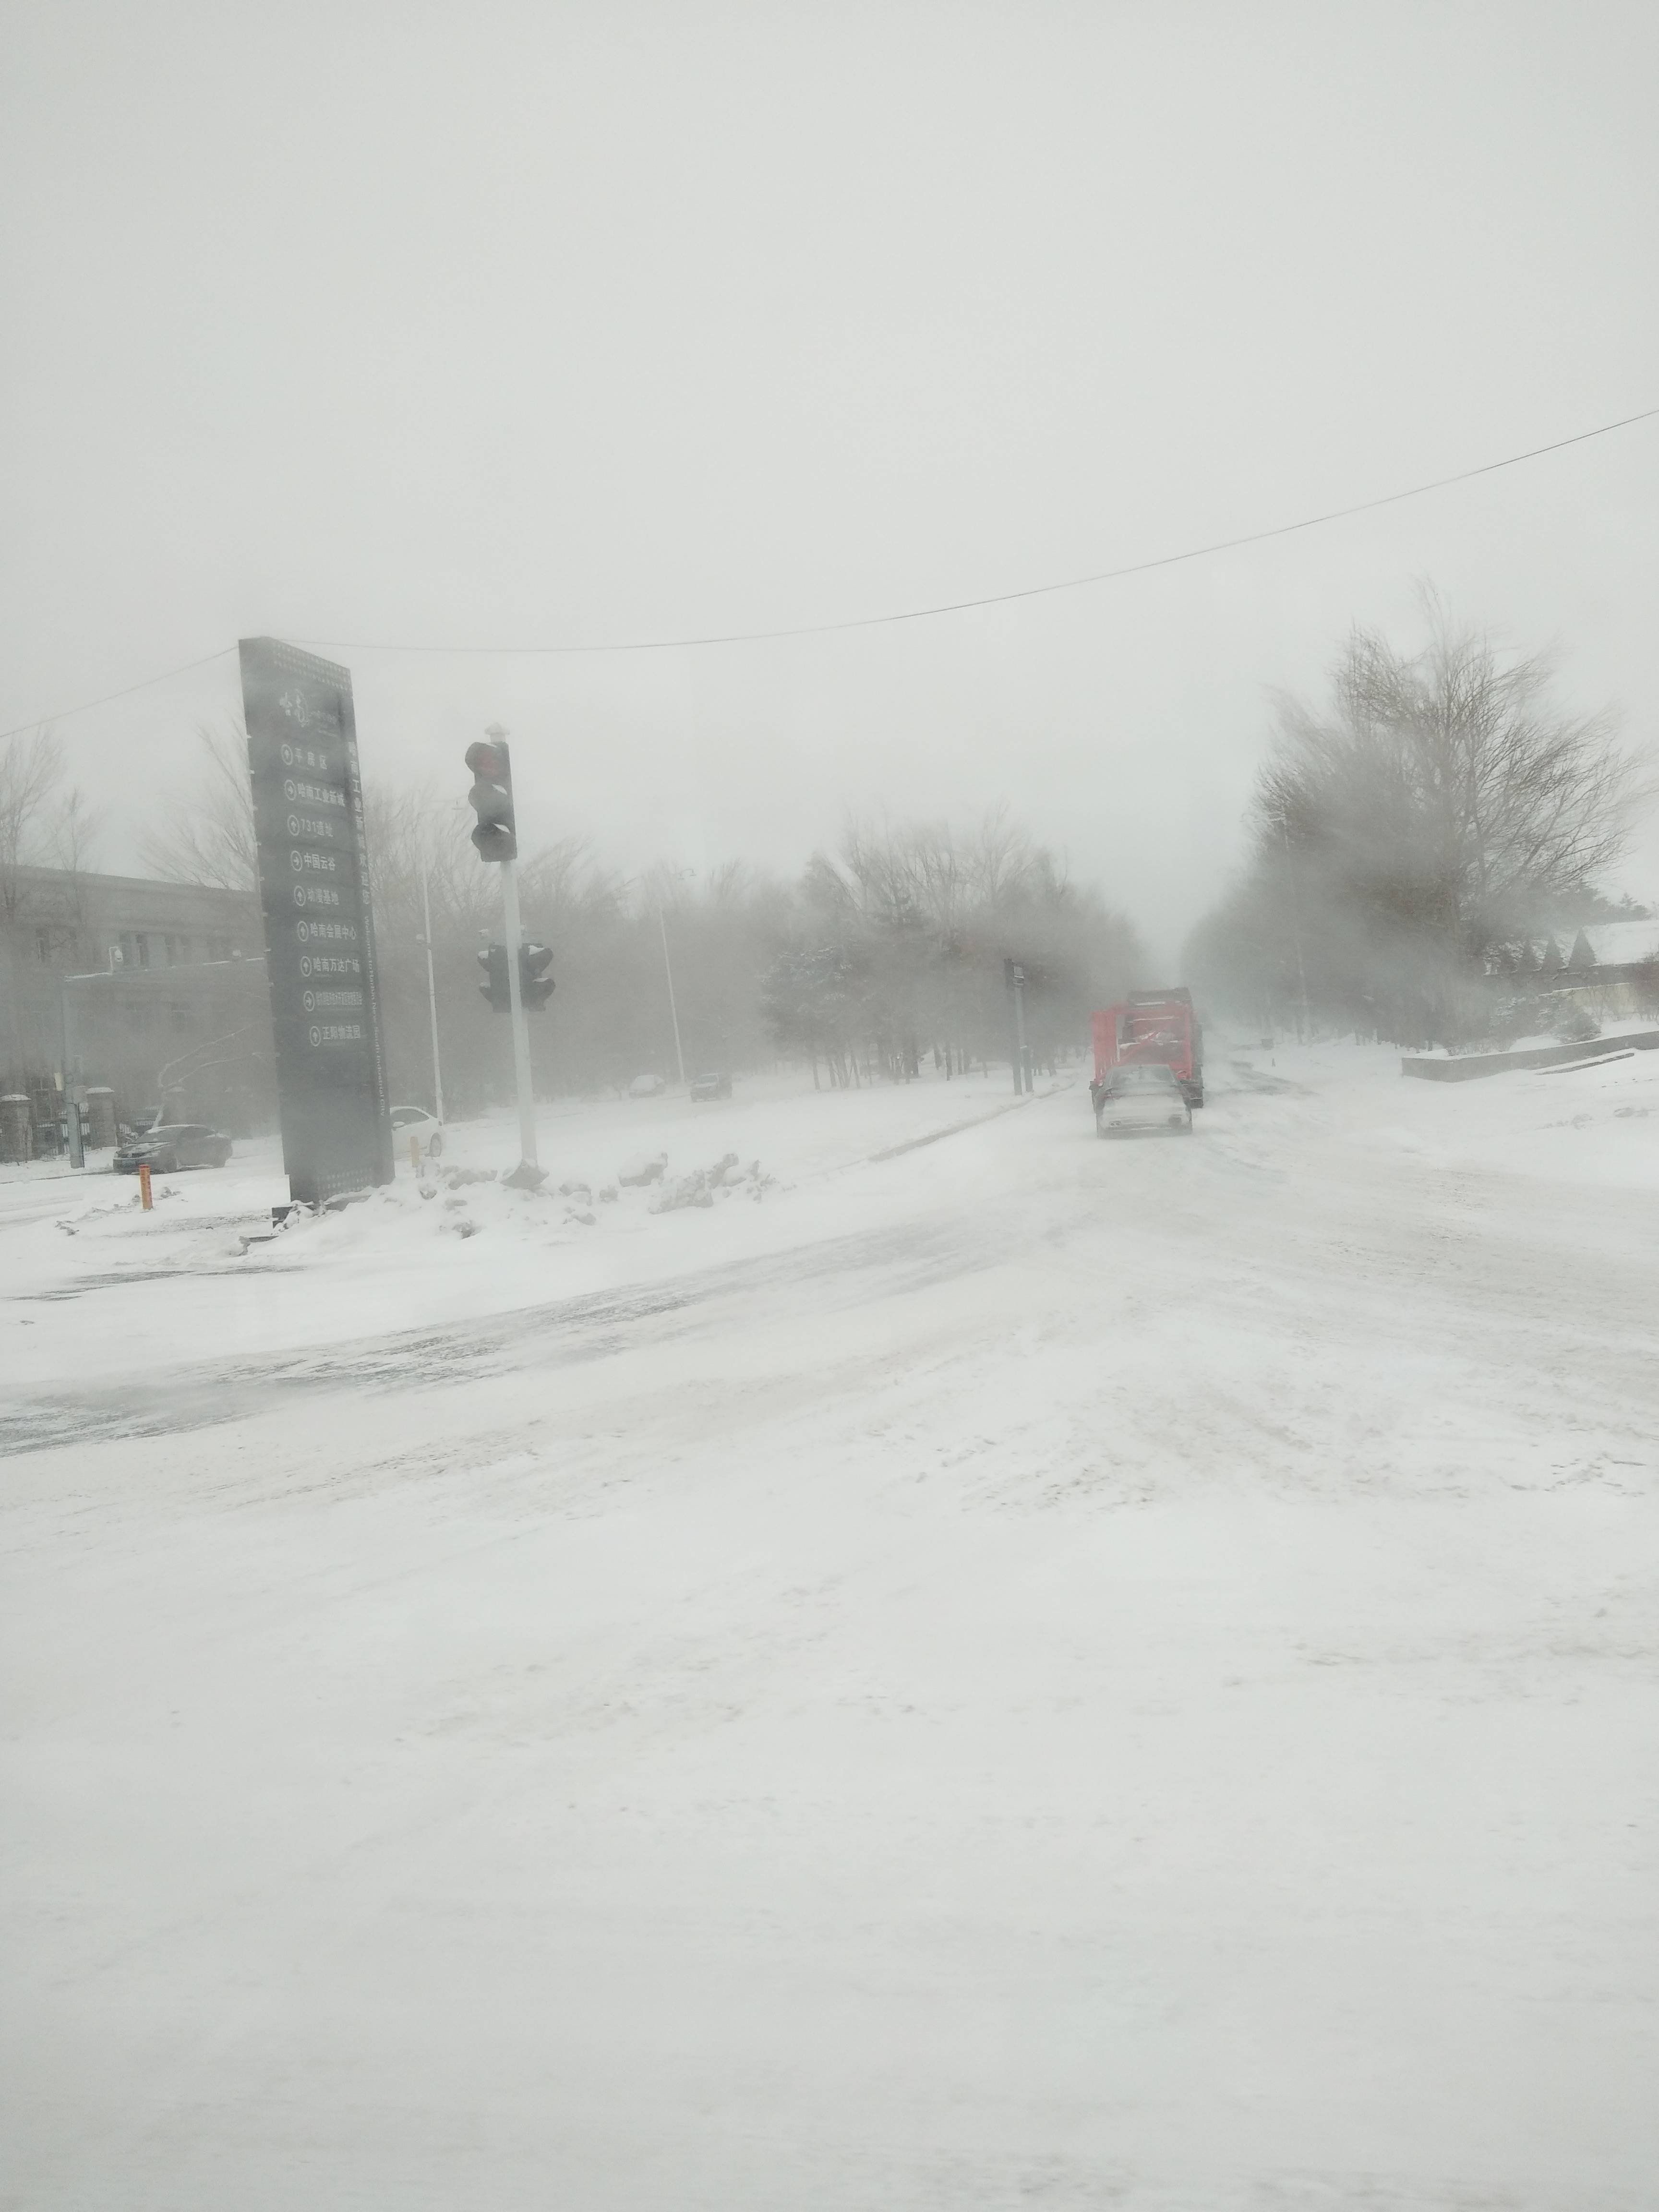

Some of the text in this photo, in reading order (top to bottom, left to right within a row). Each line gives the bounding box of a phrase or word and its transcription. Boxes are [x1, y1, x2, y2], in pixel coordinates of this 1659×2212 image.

[300, 818, 334, 837] 731遗址
[303, 852, 336, 871] 中国云谷
[307, 887, 339, 905] 动漫基地
[310, 922, 357, 940] 哈南会展中心
[313, 957, 360, 973] 哈南万达广场
